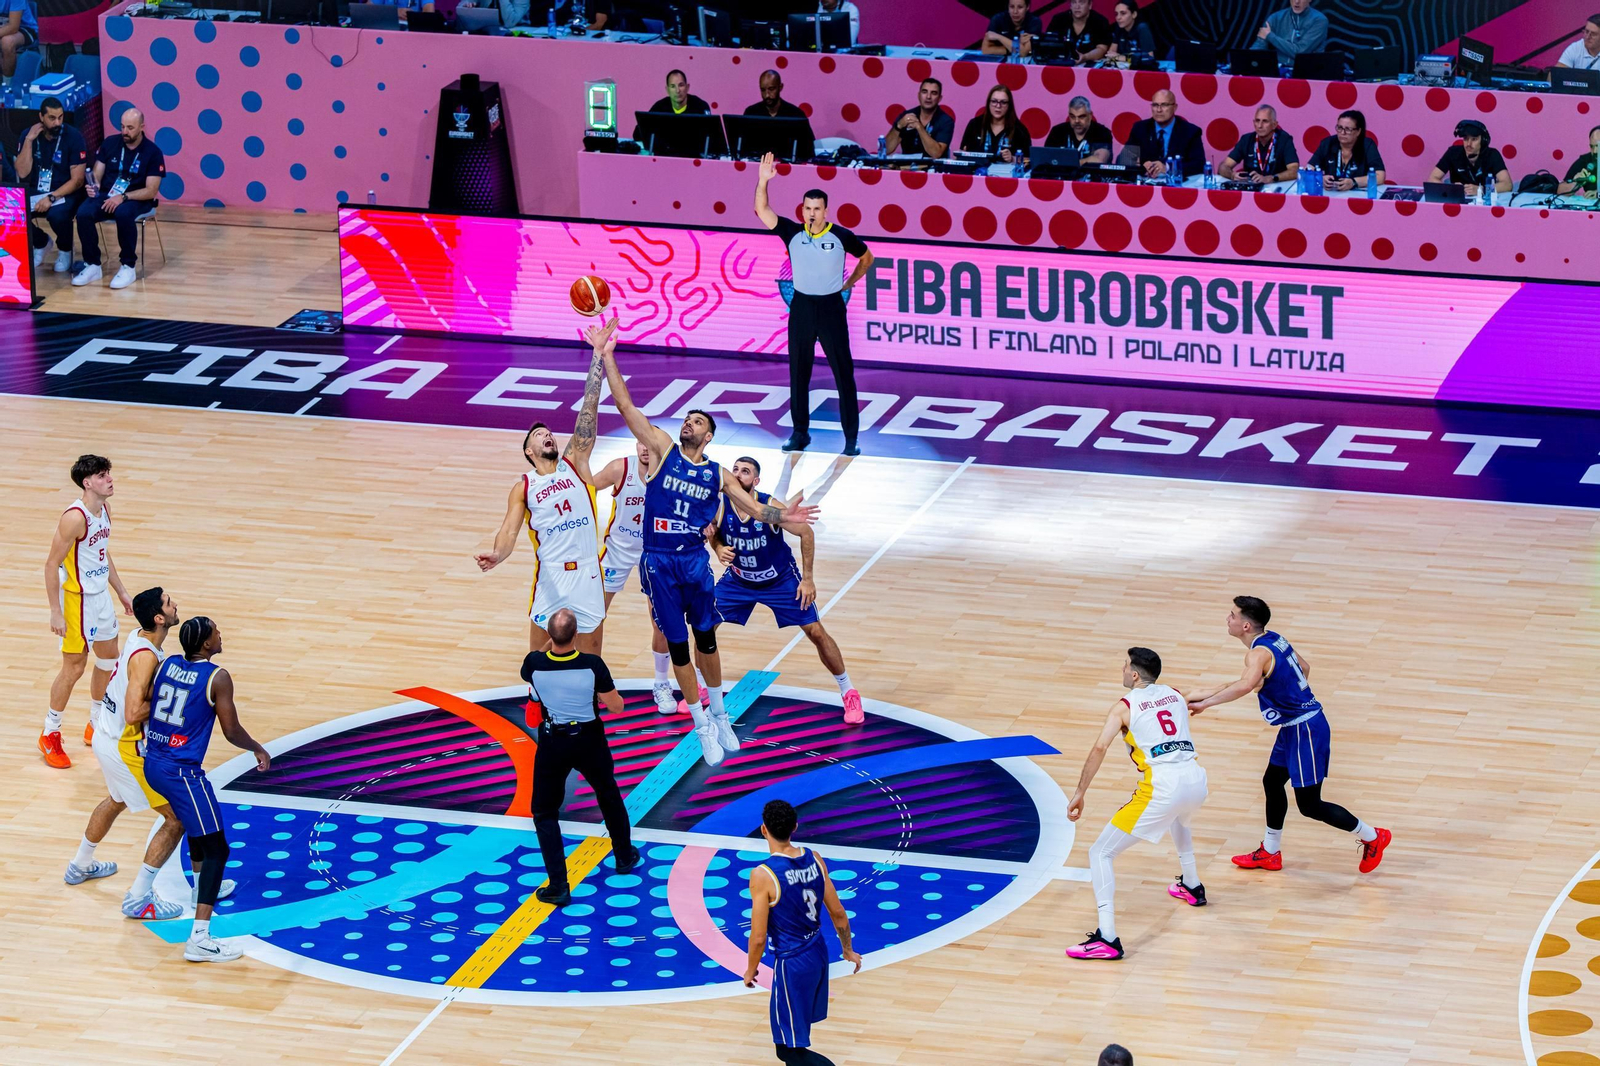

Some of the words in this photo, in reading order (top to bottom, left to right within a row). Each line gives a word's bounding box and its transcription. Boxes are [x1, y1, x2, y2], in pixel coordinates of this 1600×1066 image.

[865, 257, 982, 318] FIBA
[996, 265, 1344, 340] EUROBASKET
[866, 321, 961, 347] CYPRUS
[988, 330, 1097, 357] FINLAND
[1124, 339, 1221, 365] POLAND
[1250, 346, 1345, 373] LATVIA
[45, 338, 449, 400] FIBA
[466, 367, 1541, 476] EUROBASKET
[535, 479, 576, 504] ESPAÑA
[662, 474, 711, 500] CYPRUS
[554, 499, 572, 516] 14
[673, 499, 690, 518] 11
[546, 516, 589, 536] endesa
[632, 513, 644, 525] 4
[726, 534, 767, 550] CYPRUS
[99, 548, 105, 562] 5
[739, 555, 758, 568] 99
[742, 570, 776, 580] EKO
[153, 682, 190, 728] 21
[1156, 709, 1178, 736] 6
[802, 889, 818, 921] 3
